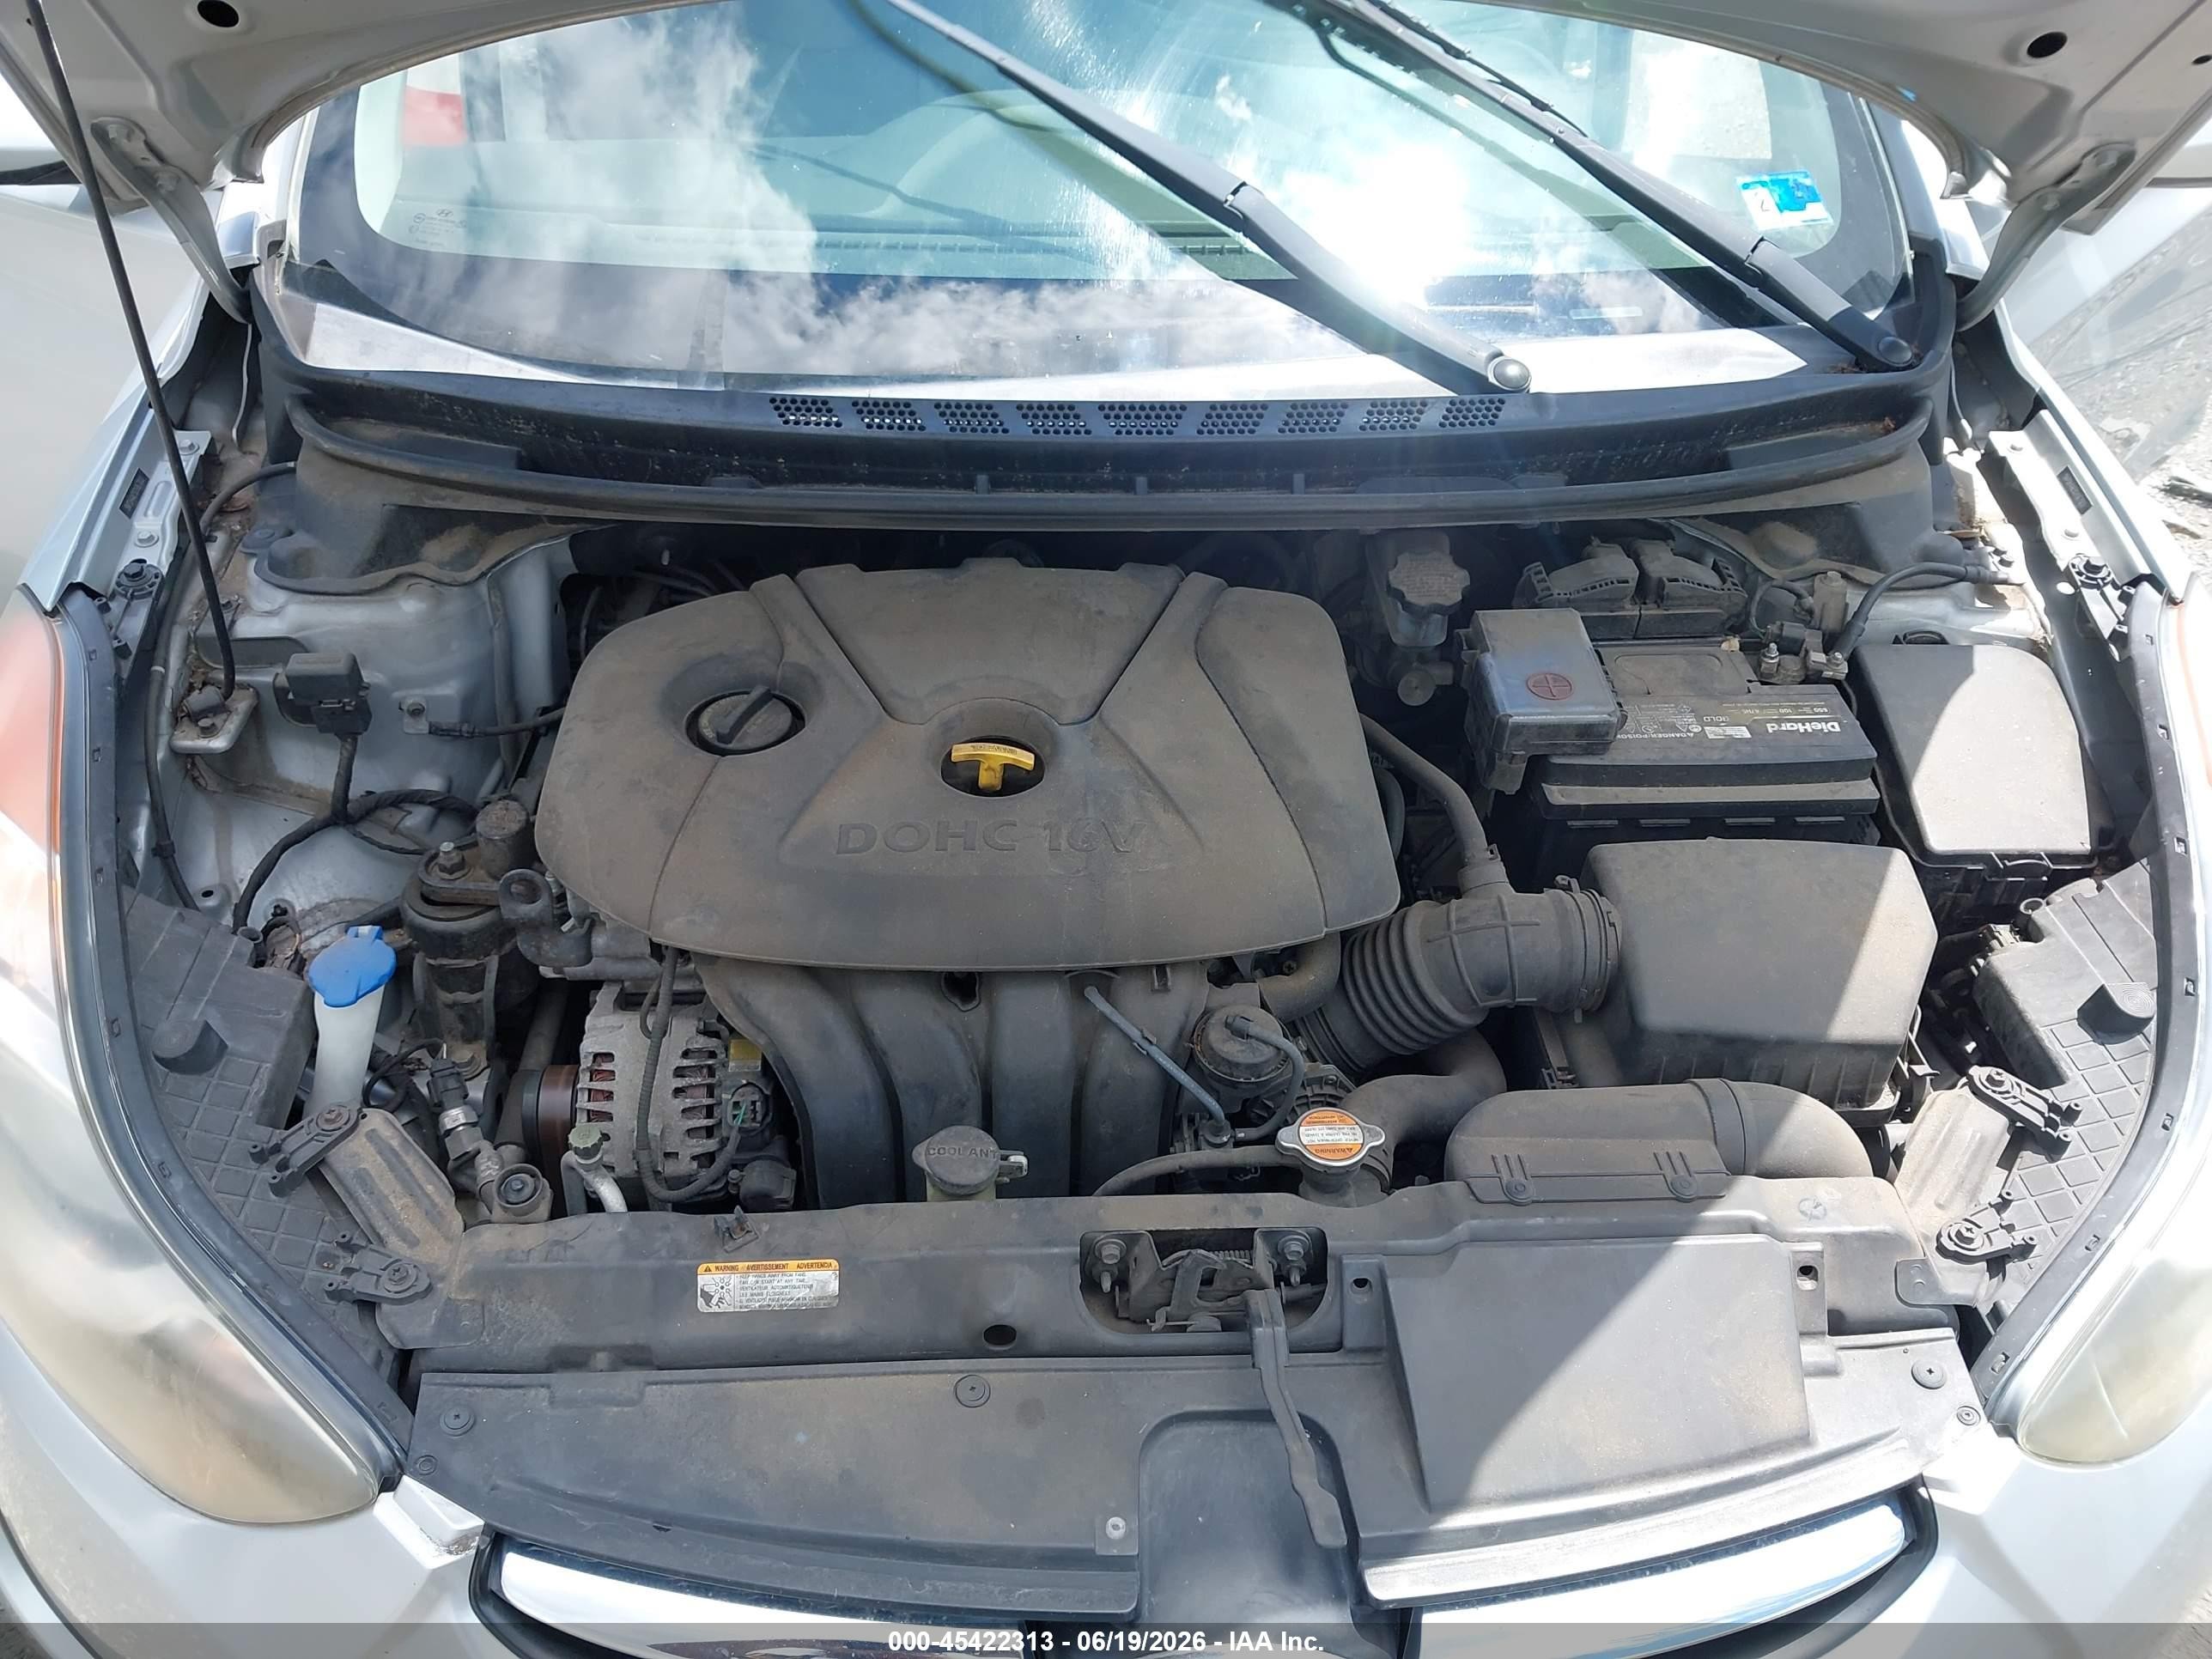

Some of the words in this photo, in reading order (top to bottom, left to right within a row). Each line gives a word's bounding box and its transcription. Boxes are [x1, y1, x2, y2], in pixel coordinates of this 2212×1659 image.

[1765, 721, 1841, 733] DieHard
[836, 819, 1018, 854] DOHC
[1043, 818, 1146, 854] 16V
[927, 1146, 997, 1159] COOLANT
